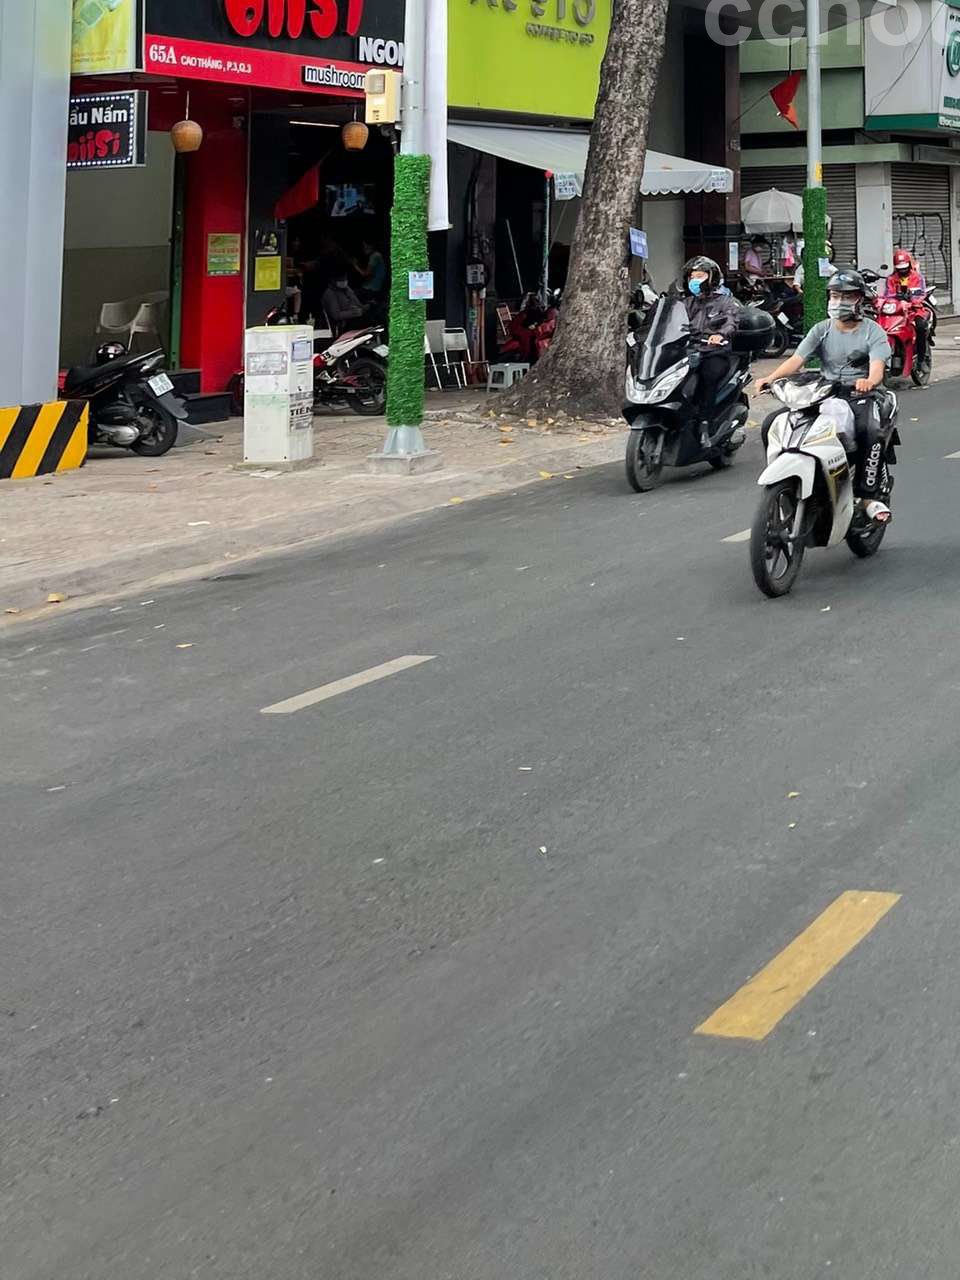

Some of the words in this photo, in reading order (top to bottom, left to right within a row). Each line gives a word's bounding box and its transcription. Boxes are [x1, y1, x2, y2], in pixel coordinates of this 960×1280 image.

[149, 43, 177, 65] 65A
[305, 66, 366, 88] mushroom
[69, 105, 88, 126] ẩu
[91, 103, 128, 124] Nấm
[866, 443, 881, 487] adidas
